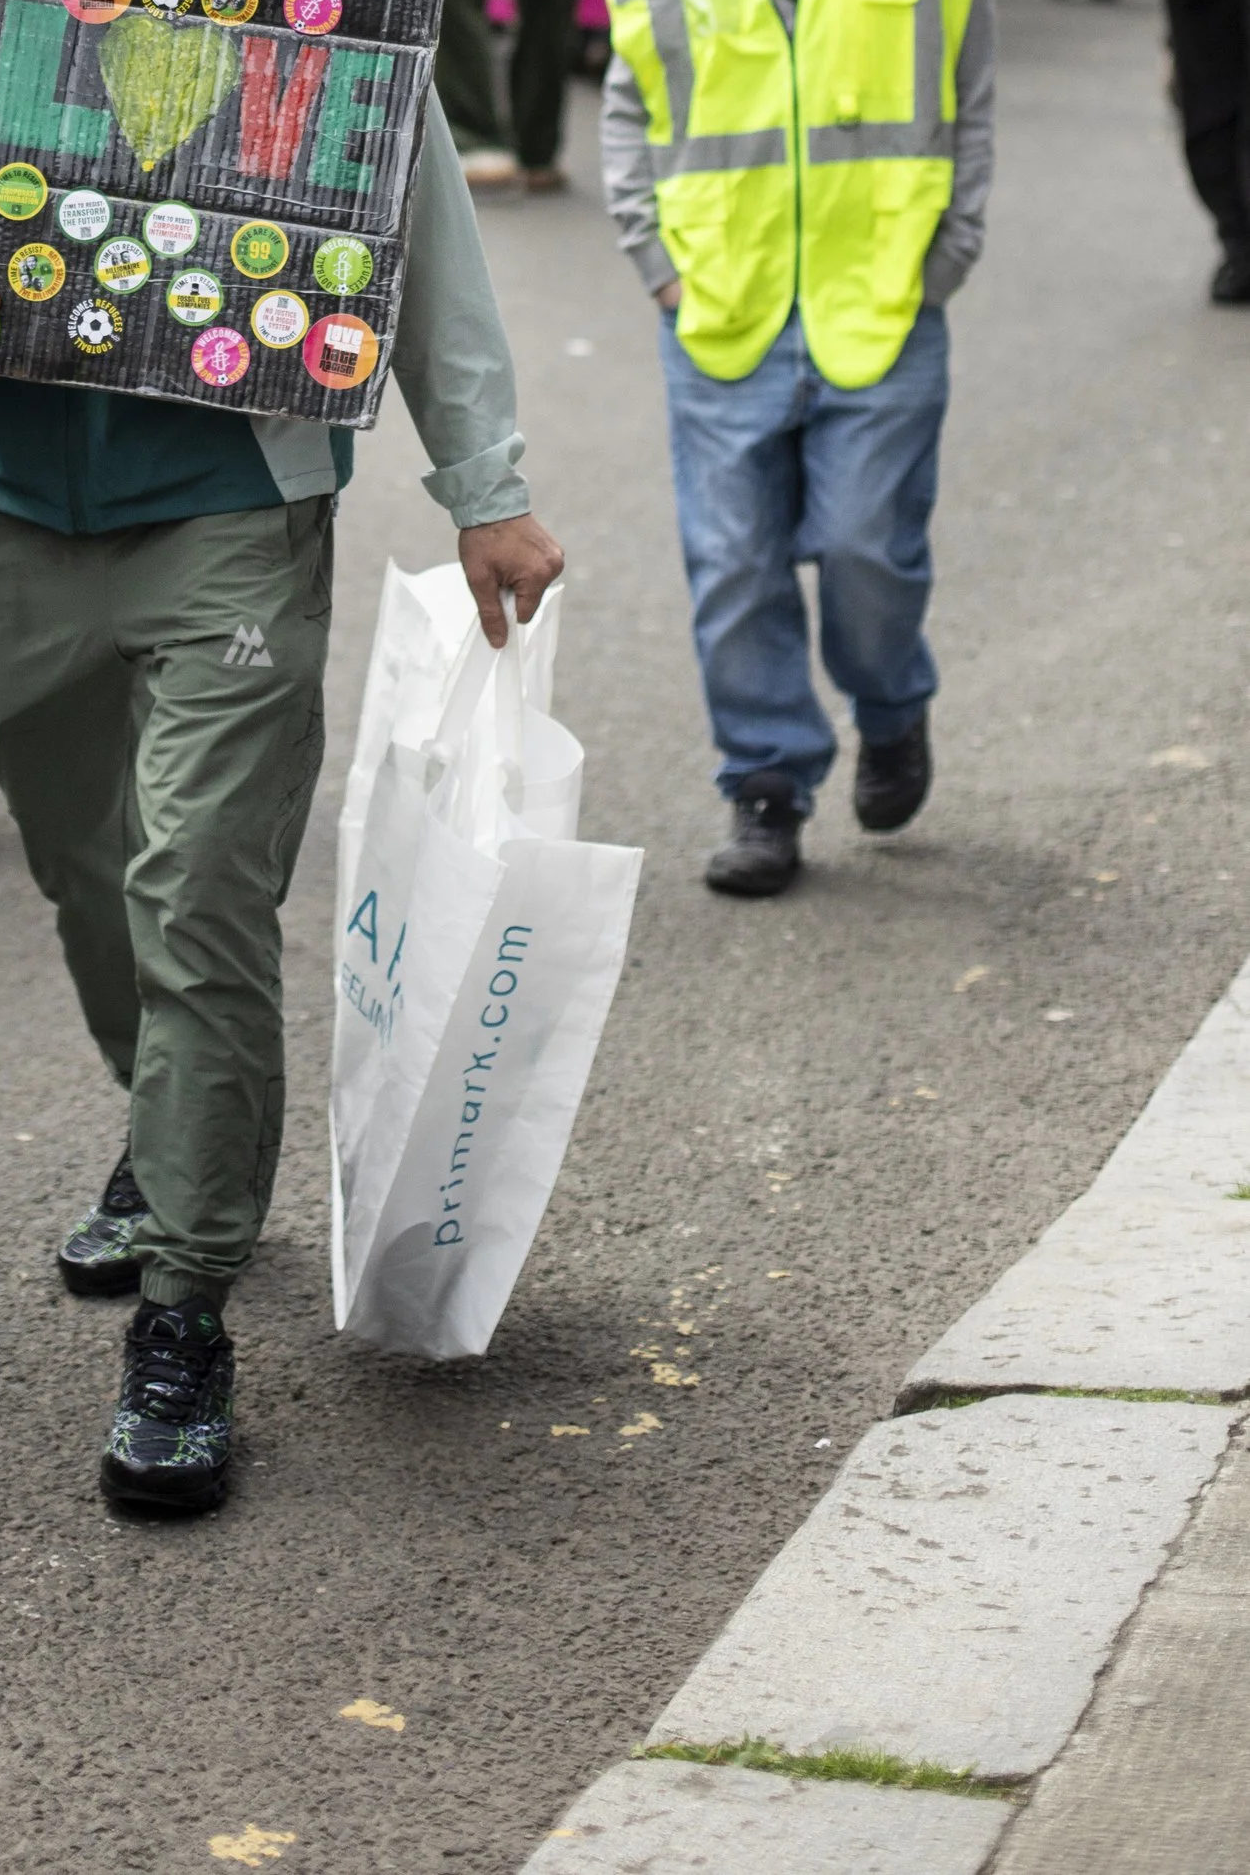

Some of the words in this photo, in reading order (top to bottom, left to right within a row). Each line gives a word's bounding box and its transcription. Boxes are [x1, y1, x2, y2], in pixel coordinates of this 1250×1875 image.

[62, 208, 106, 218] TRANSFORM
[62, 218, 76, 226] THE
[78, 215, 107, 225] FUTURE!
[152, 214, 165, 222] TIME
[148, 228, 193, 241] INTIMIDATION
[153, 222, 191, 233] CORPORATE
[19, 246, 43, 258] RESIST
[101, 249, 113, 263] TIME
[112, 244, 121, 252] TO
[121, 243, 142, 257] RESIST
[250, 241, 271, 260] 99
[12, 257, 21, 265] TO
[10, 267, 19, 284] TIME
[316, 256, 337, 292] FOOTBALL
[349, 254, 371, 292] REFUGEES
[175, 277, 189, 291] TIME
[199, 276, 217, 293] RESIST
[177, 302, 210, 310] COMPANIES
[197, 296, 211, 304] FUEL
[68, 299, 94, 338] WELCOMES
[95, 298, 123, 333] REFUGEES
[74, 337, 113, 354] FOOTBALL
[197, 329, 241, 347] WELCOMES
[432, 925, 533, 1248] primark.com
